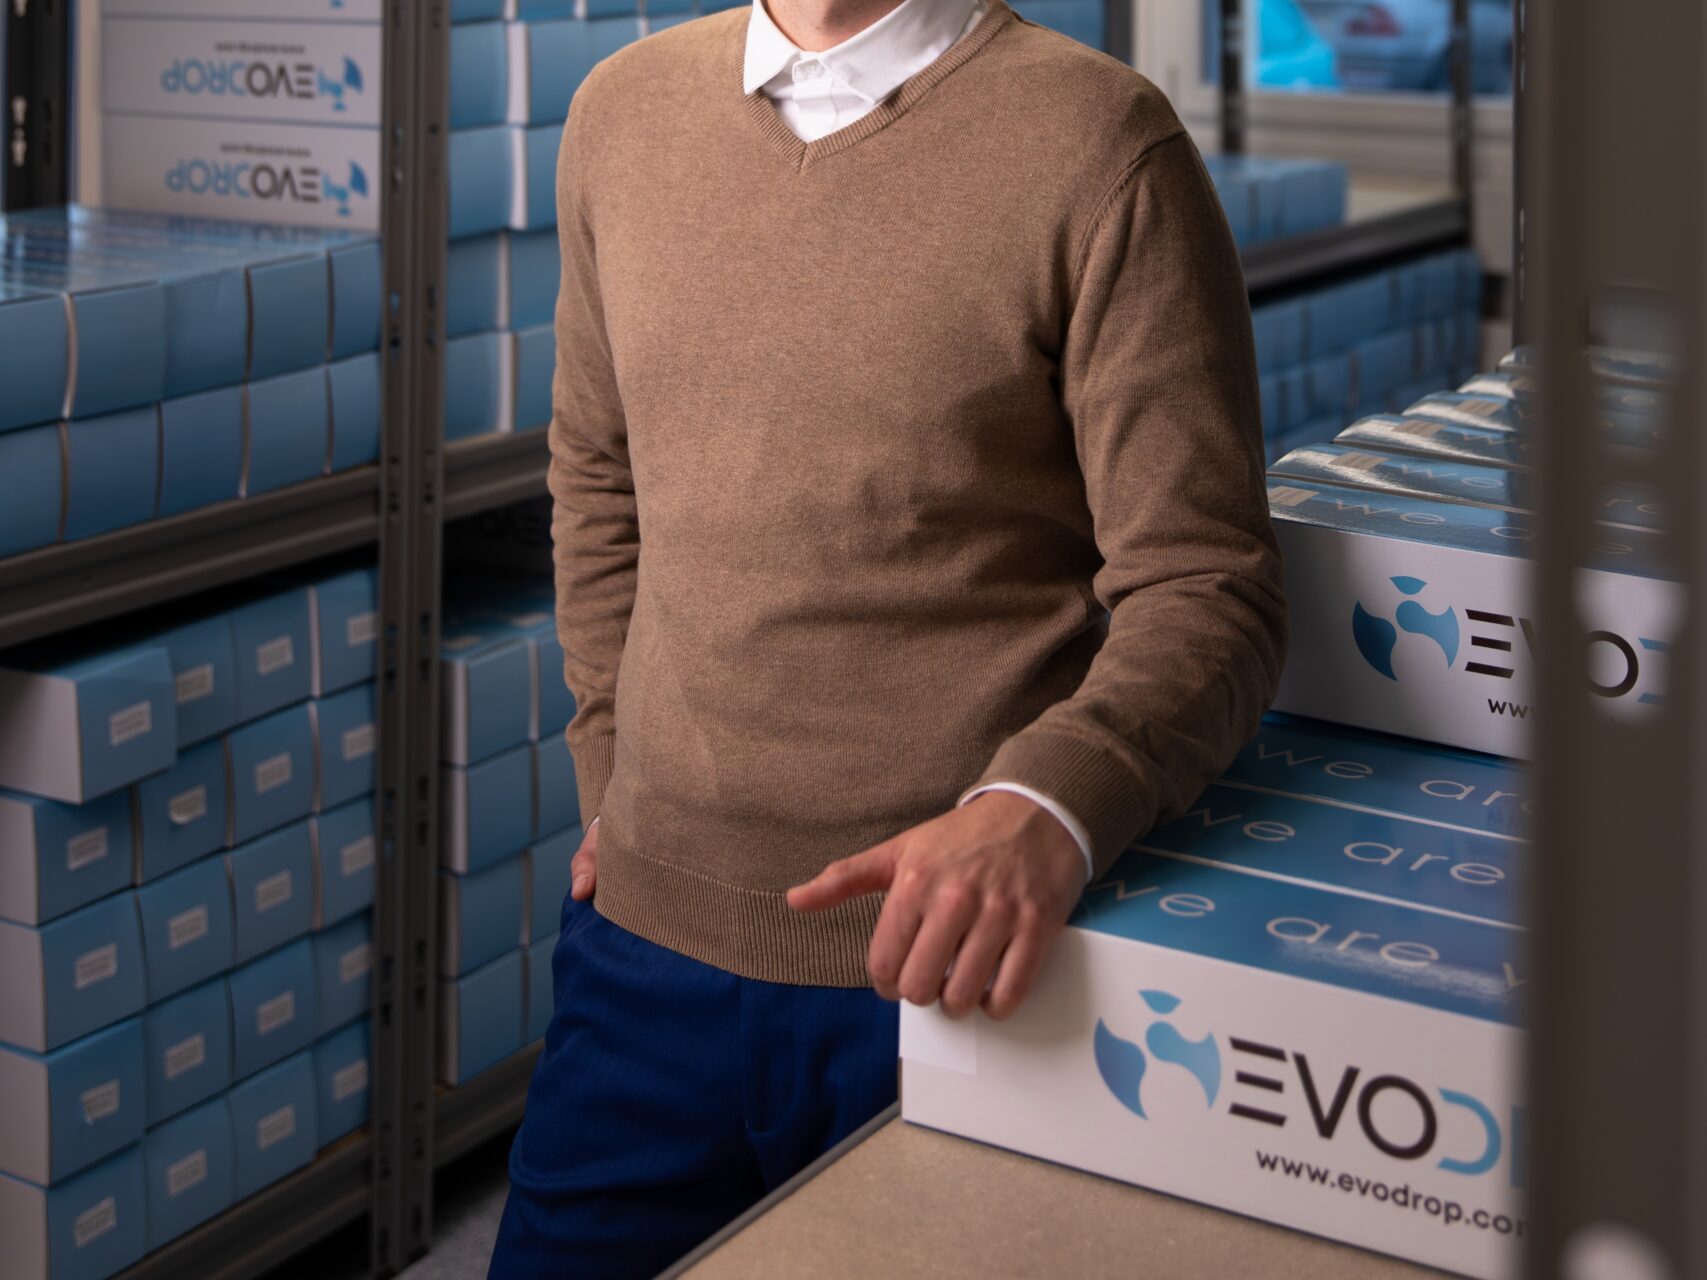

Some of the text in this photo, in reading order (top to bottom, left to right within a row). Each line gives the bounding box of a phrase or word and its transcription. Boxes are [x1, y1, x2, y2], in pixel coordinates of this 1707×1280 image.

[1258, 743, 1533, 815] we ar
[1343, 841, 1506, 885] are
[1265, 916, 1440, 968] are
[1228, 1036, 1529, 1191] EVOD
